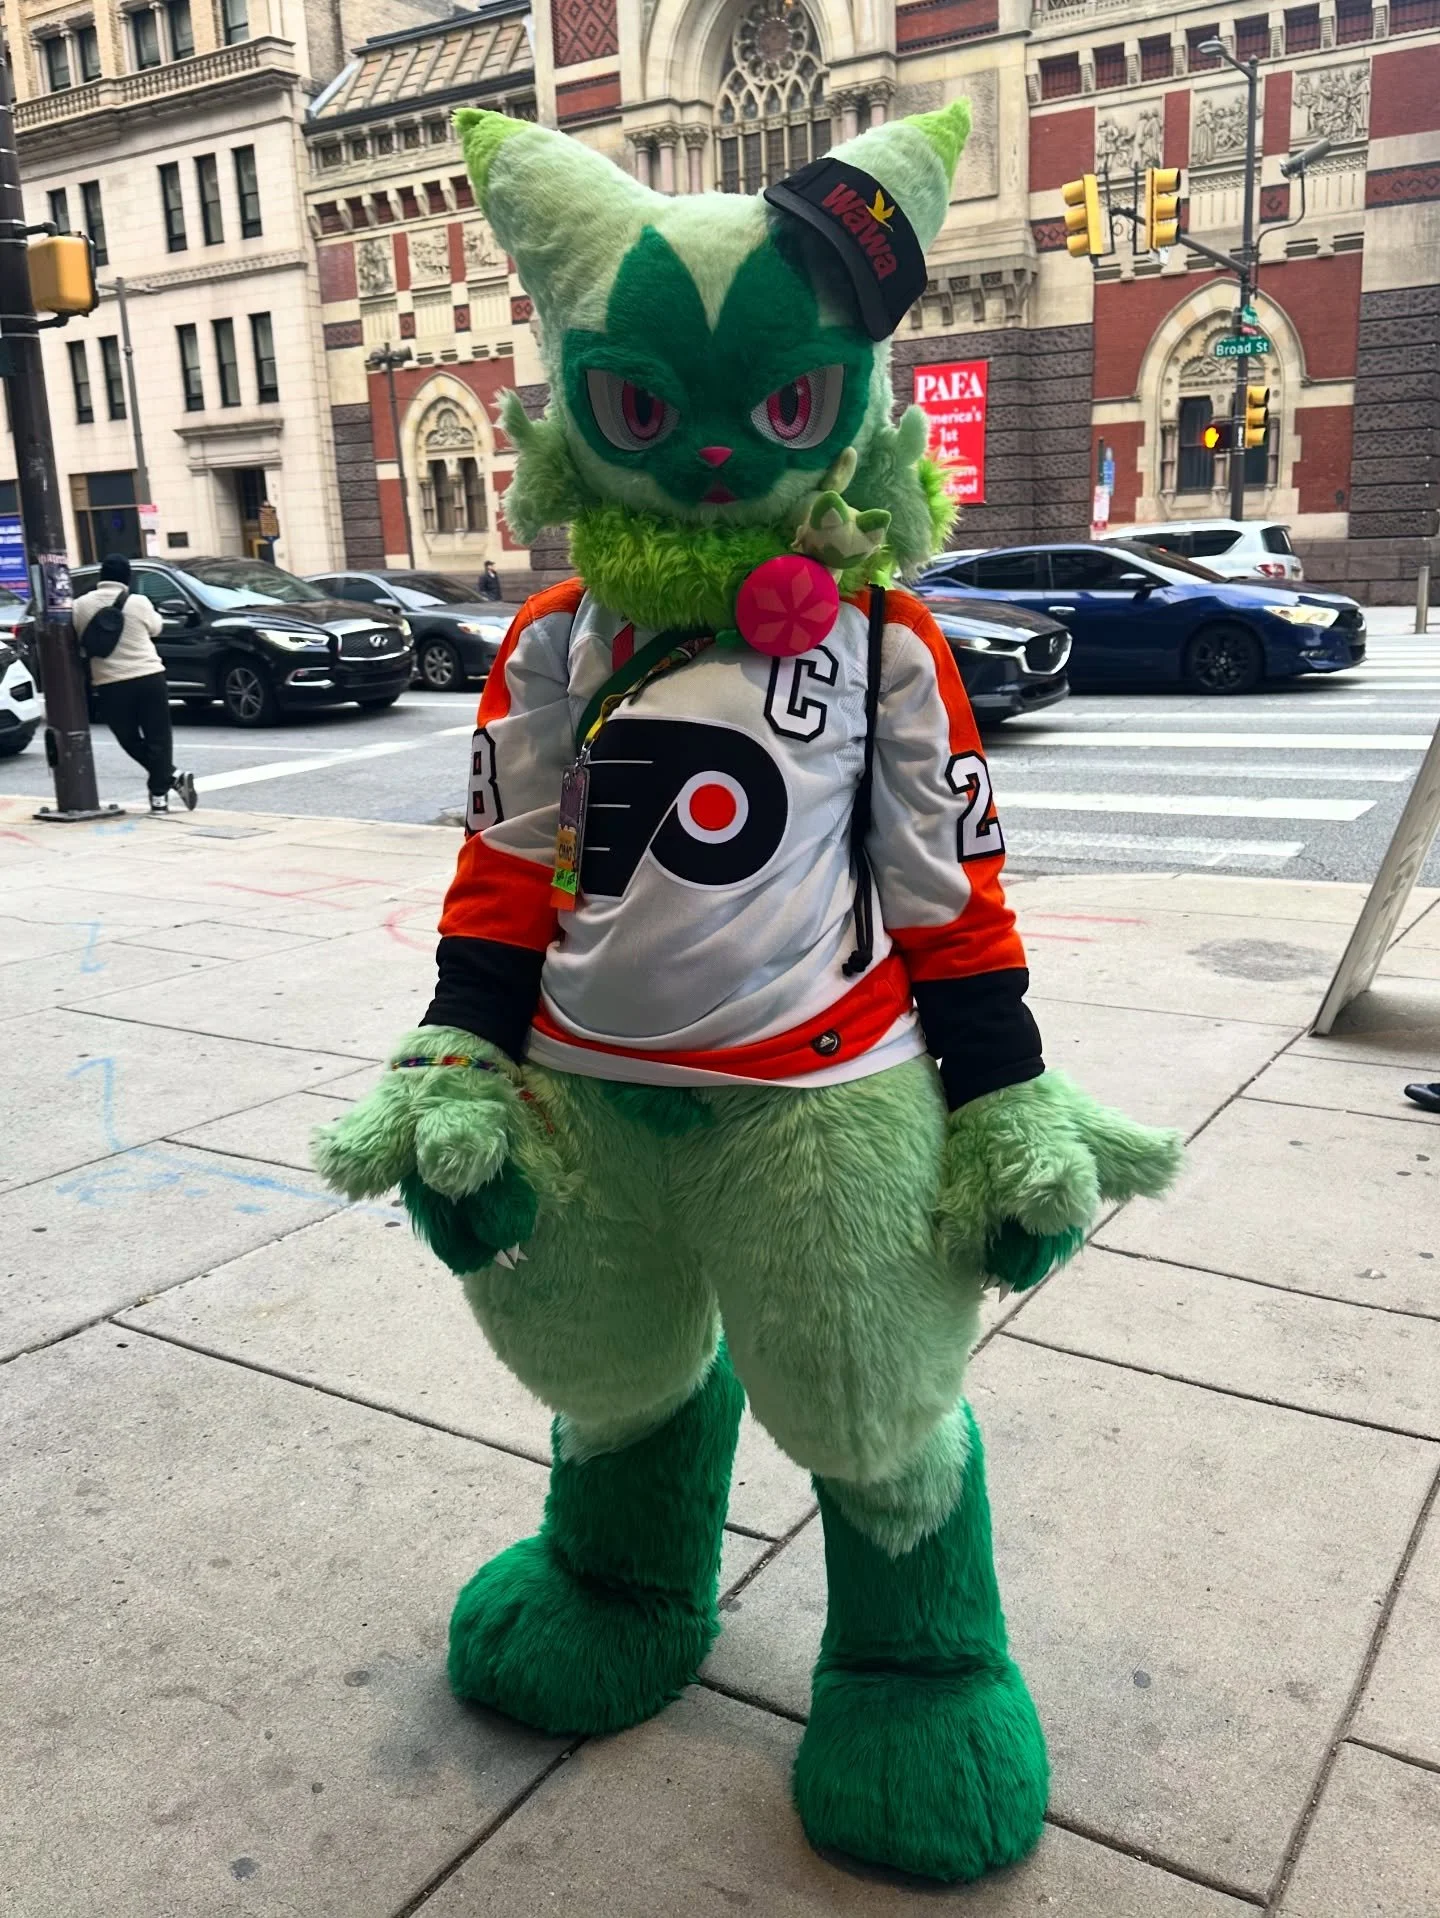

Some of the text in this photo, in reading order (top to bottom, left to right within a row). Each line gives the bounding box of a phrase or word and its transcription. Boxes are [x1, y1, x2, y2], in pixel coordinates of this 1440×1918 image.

[822, 183, 897, 280] Wawa
[1215, 342, 1268, 356] Broad St
[917, 372, 984, 402] PAFA
[929, 406, 982, 424] merica's
[940, 426, 959, 442] 1st
[764, 644, 839, 743] C
[944, 749, 1005, 863] 2
